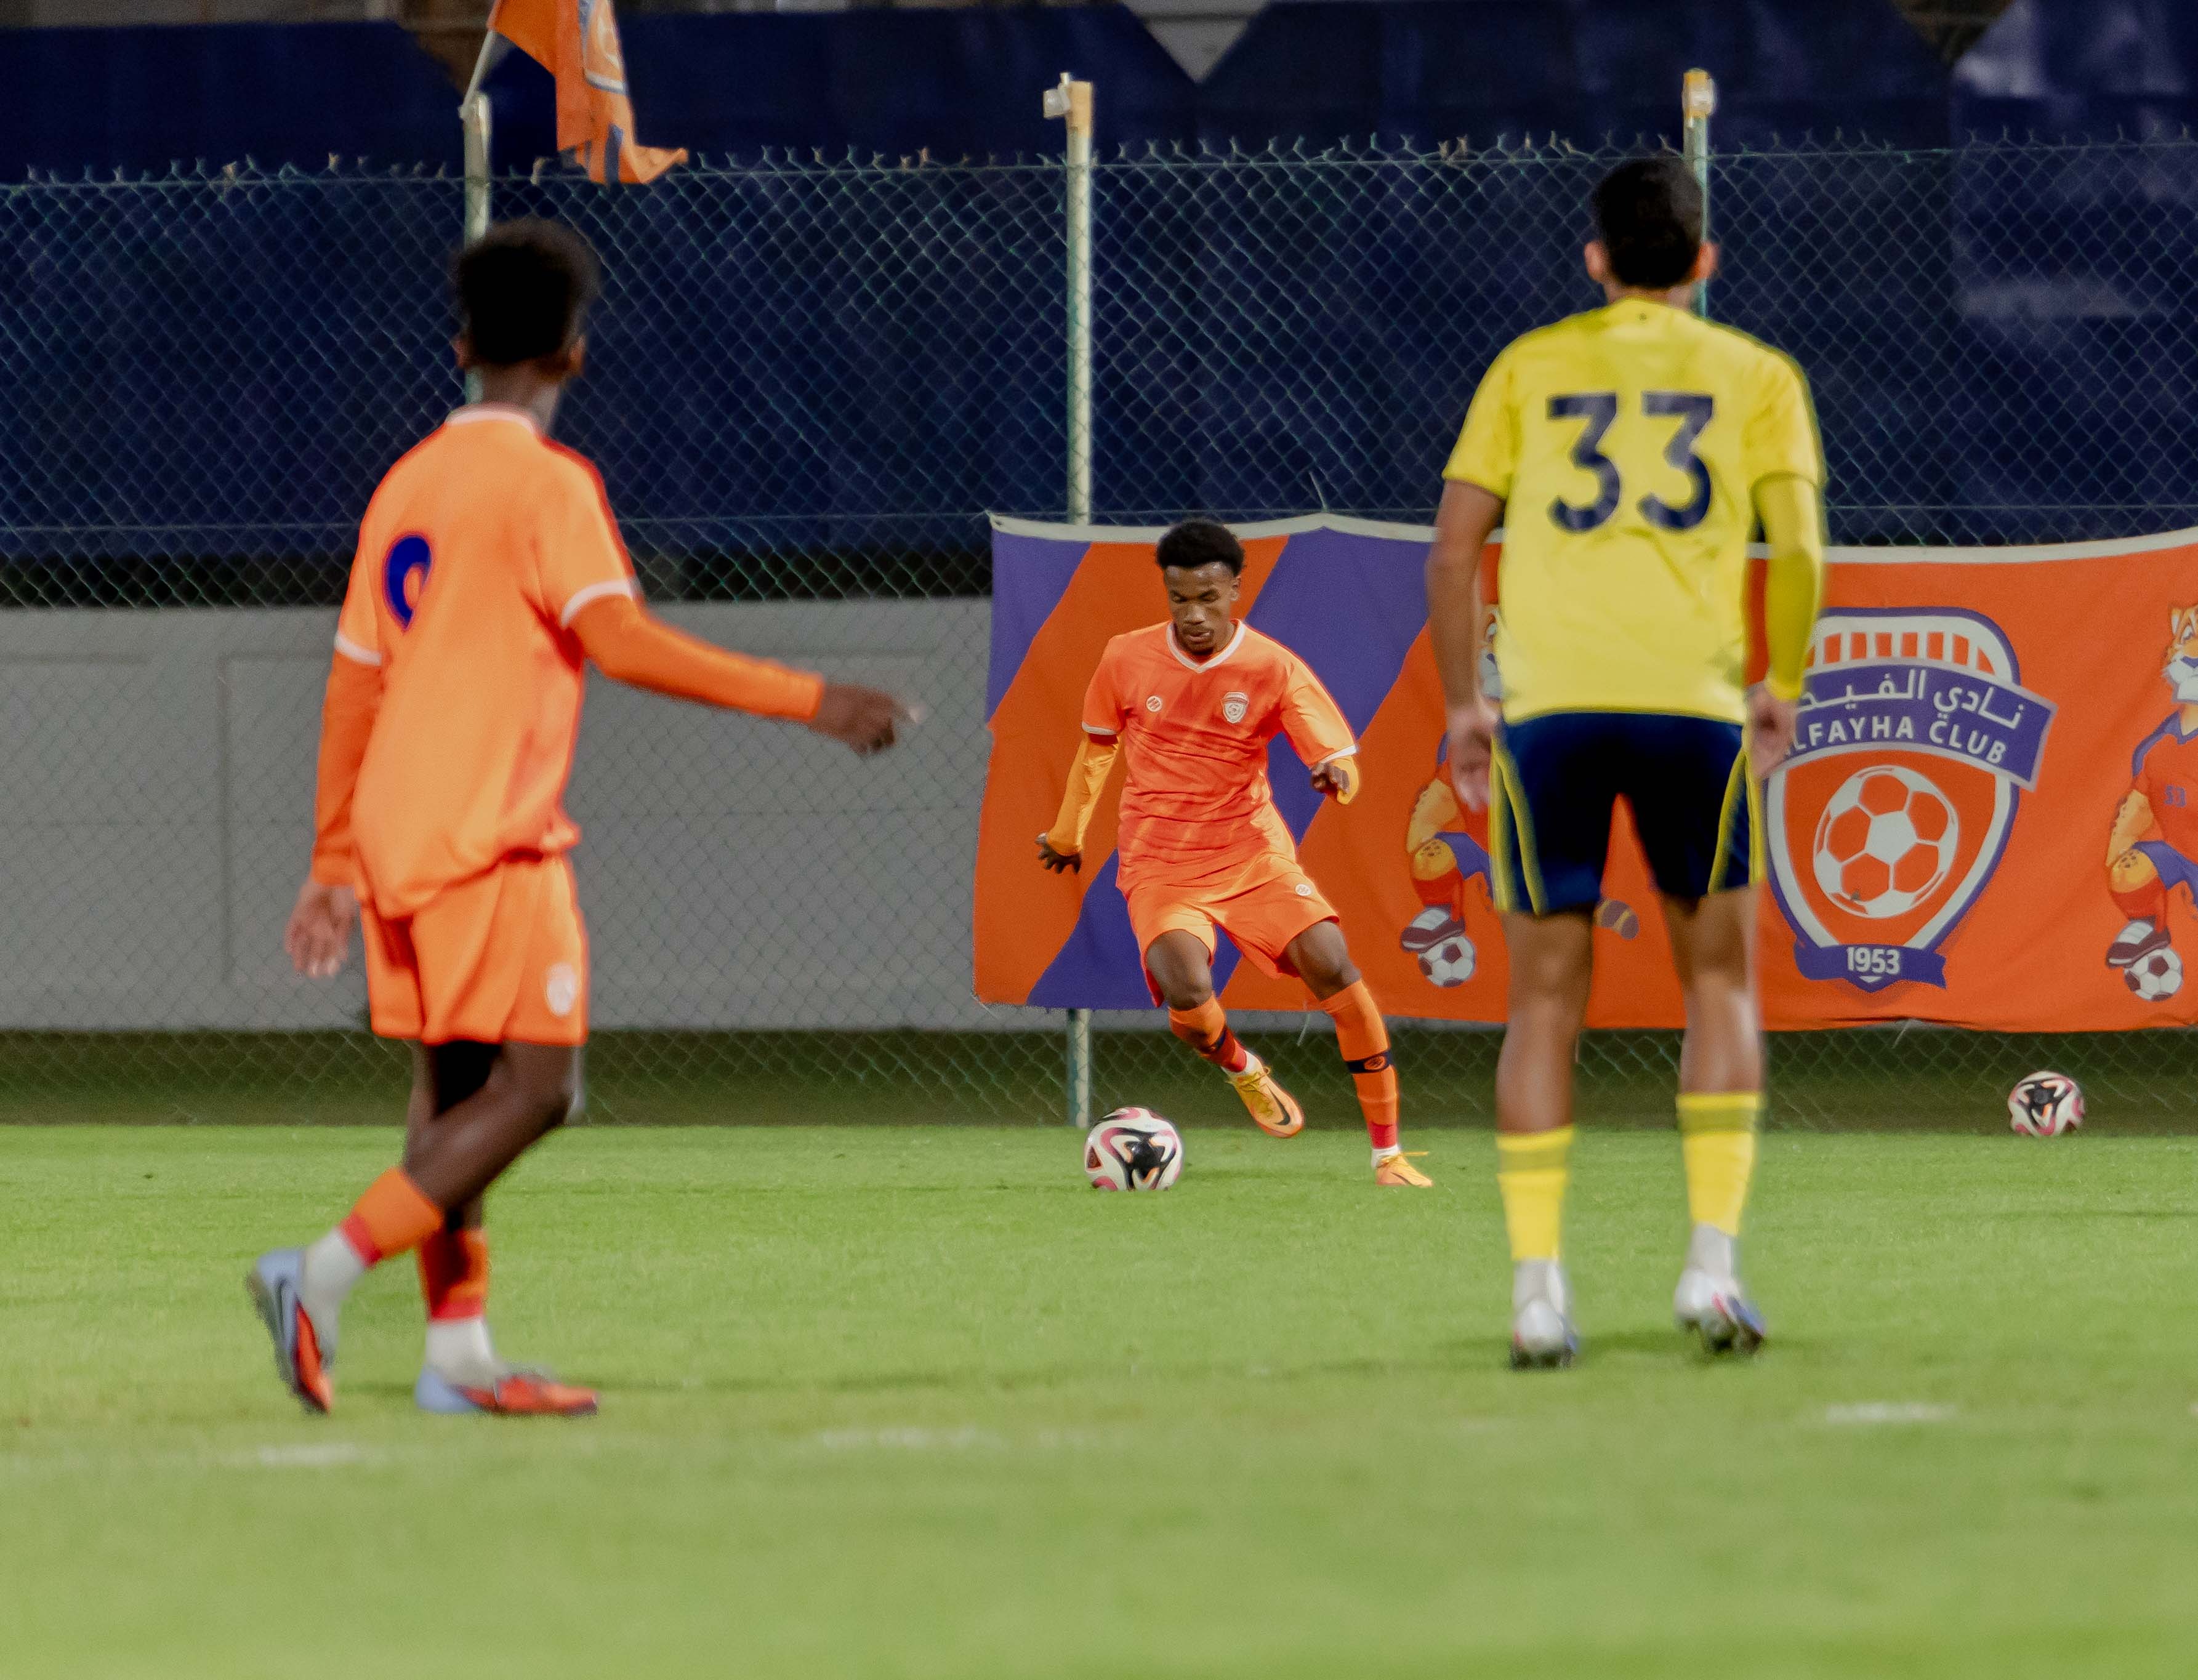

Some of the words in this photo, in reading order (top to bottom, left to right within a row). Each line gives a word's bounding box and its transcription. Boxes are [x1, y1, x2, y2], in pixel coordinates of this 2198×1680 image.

[1547, 392, 1714, 534] 33
[1933, 686, 2025, 729] نادي
[1786, 715, 1914, 756] LFAYHA
[1928, 720, 2007, 765] CLUB
[1846, 946, 1901, 975] 1953
